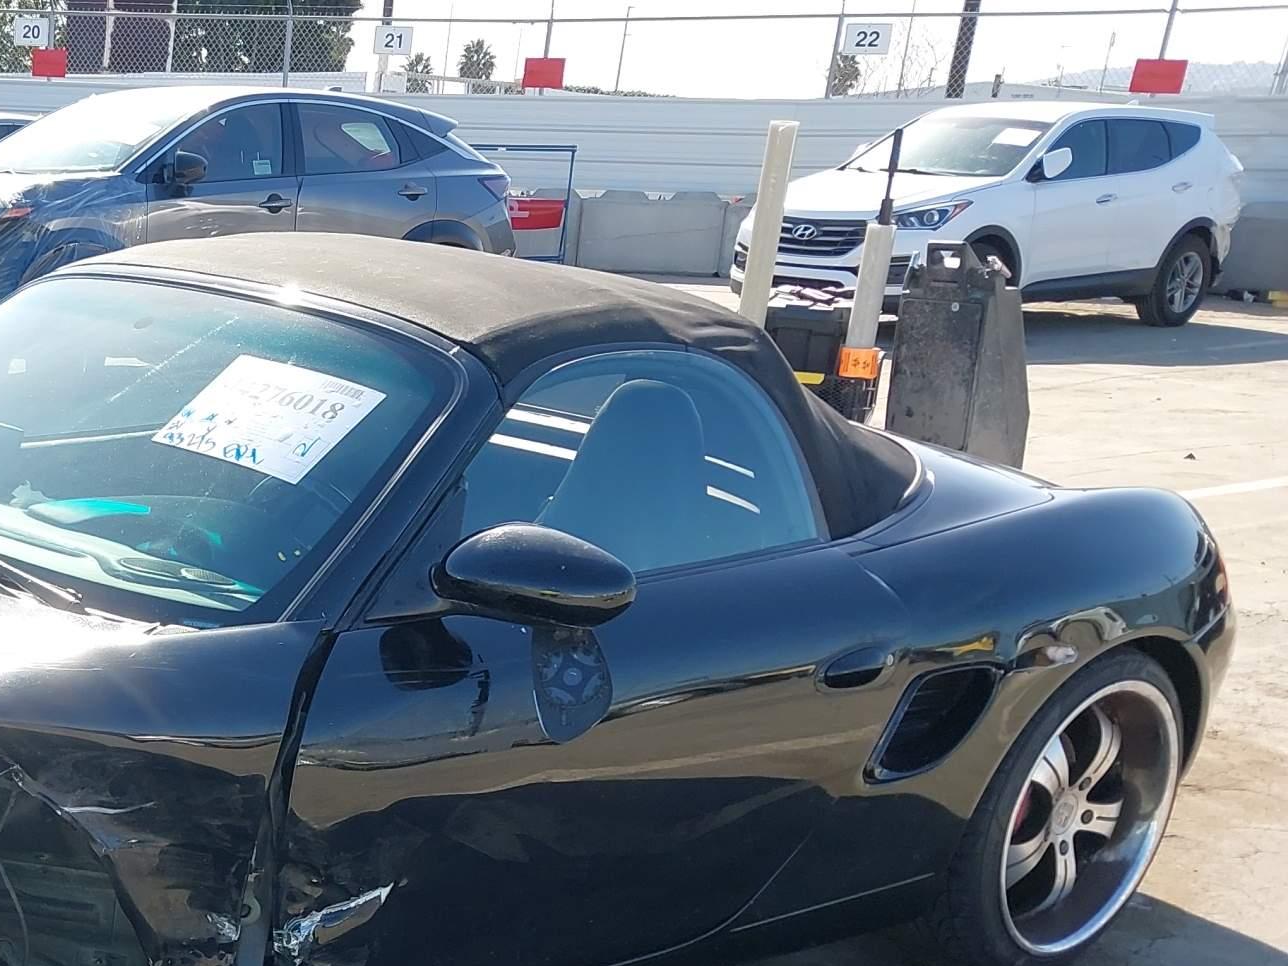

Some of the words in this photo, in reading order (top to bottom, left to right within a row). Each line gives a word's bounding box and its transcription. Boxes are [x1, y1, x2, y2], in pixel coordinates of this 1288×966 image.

[22, 24, 41, 39] 20
[855, 30, 880, 47] 22
[384, 33, 403, 48] 21
